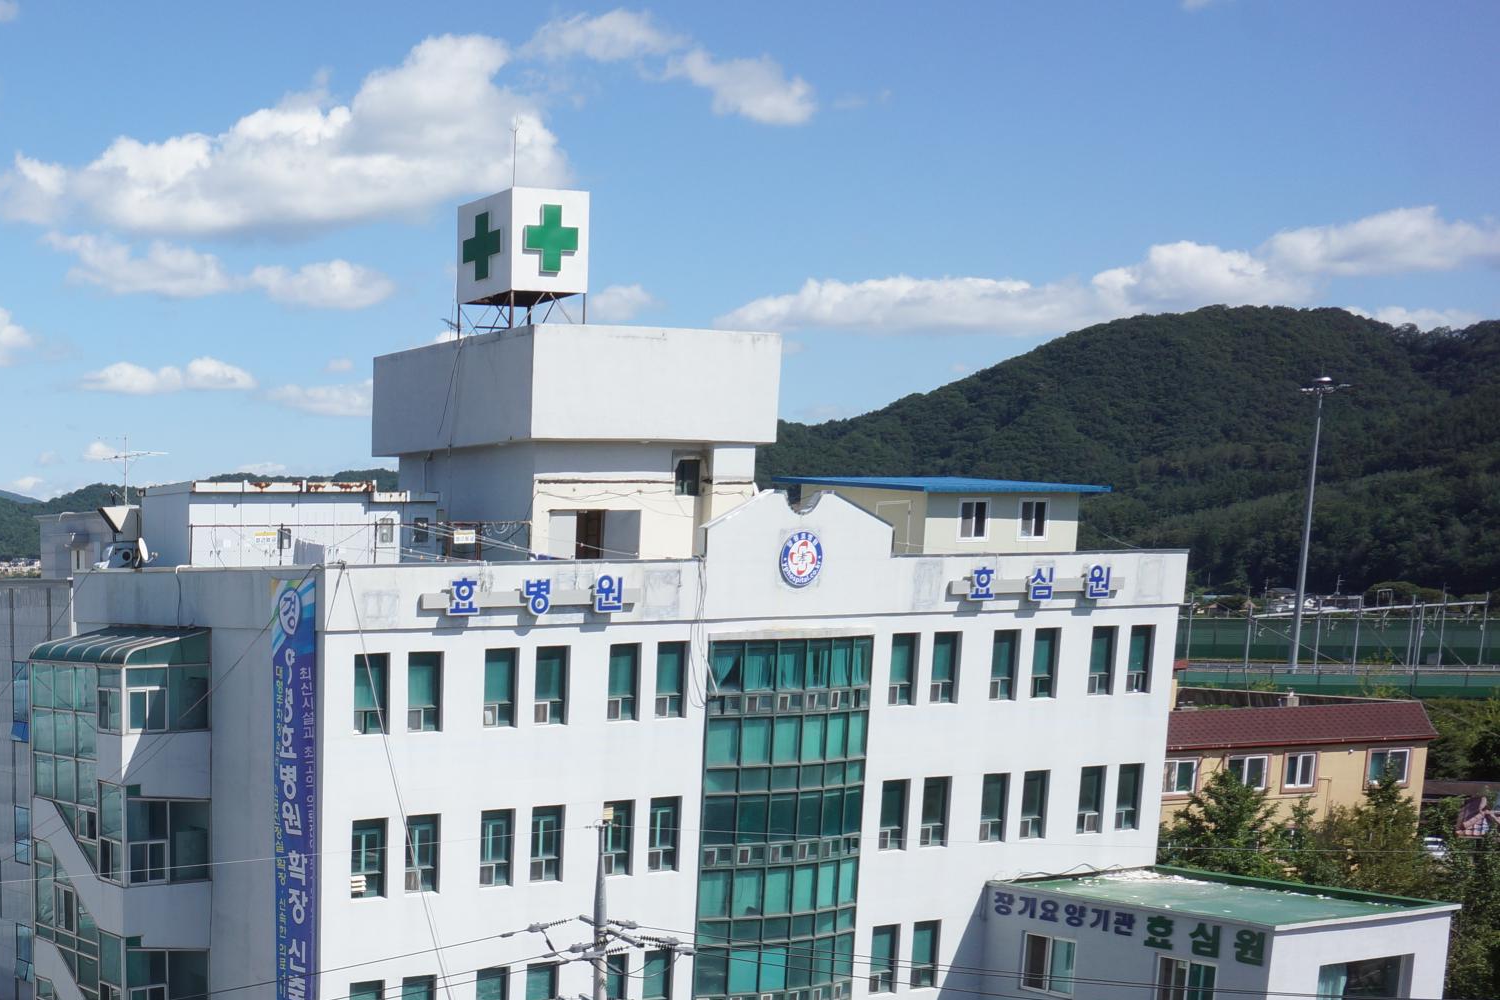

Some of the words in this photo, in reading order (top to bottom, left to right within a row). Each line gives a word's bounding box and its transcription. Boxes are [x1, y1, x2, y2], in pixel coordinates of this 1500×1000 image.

[448, 574, 625, 617] 효병원
[968, 562, 1114, 601] 효심원
[287, 849, 309, 925] 확장
[993, 891, 1135, 938] 장기요양기관
[1143, 915, 1267, 968] 효심원
